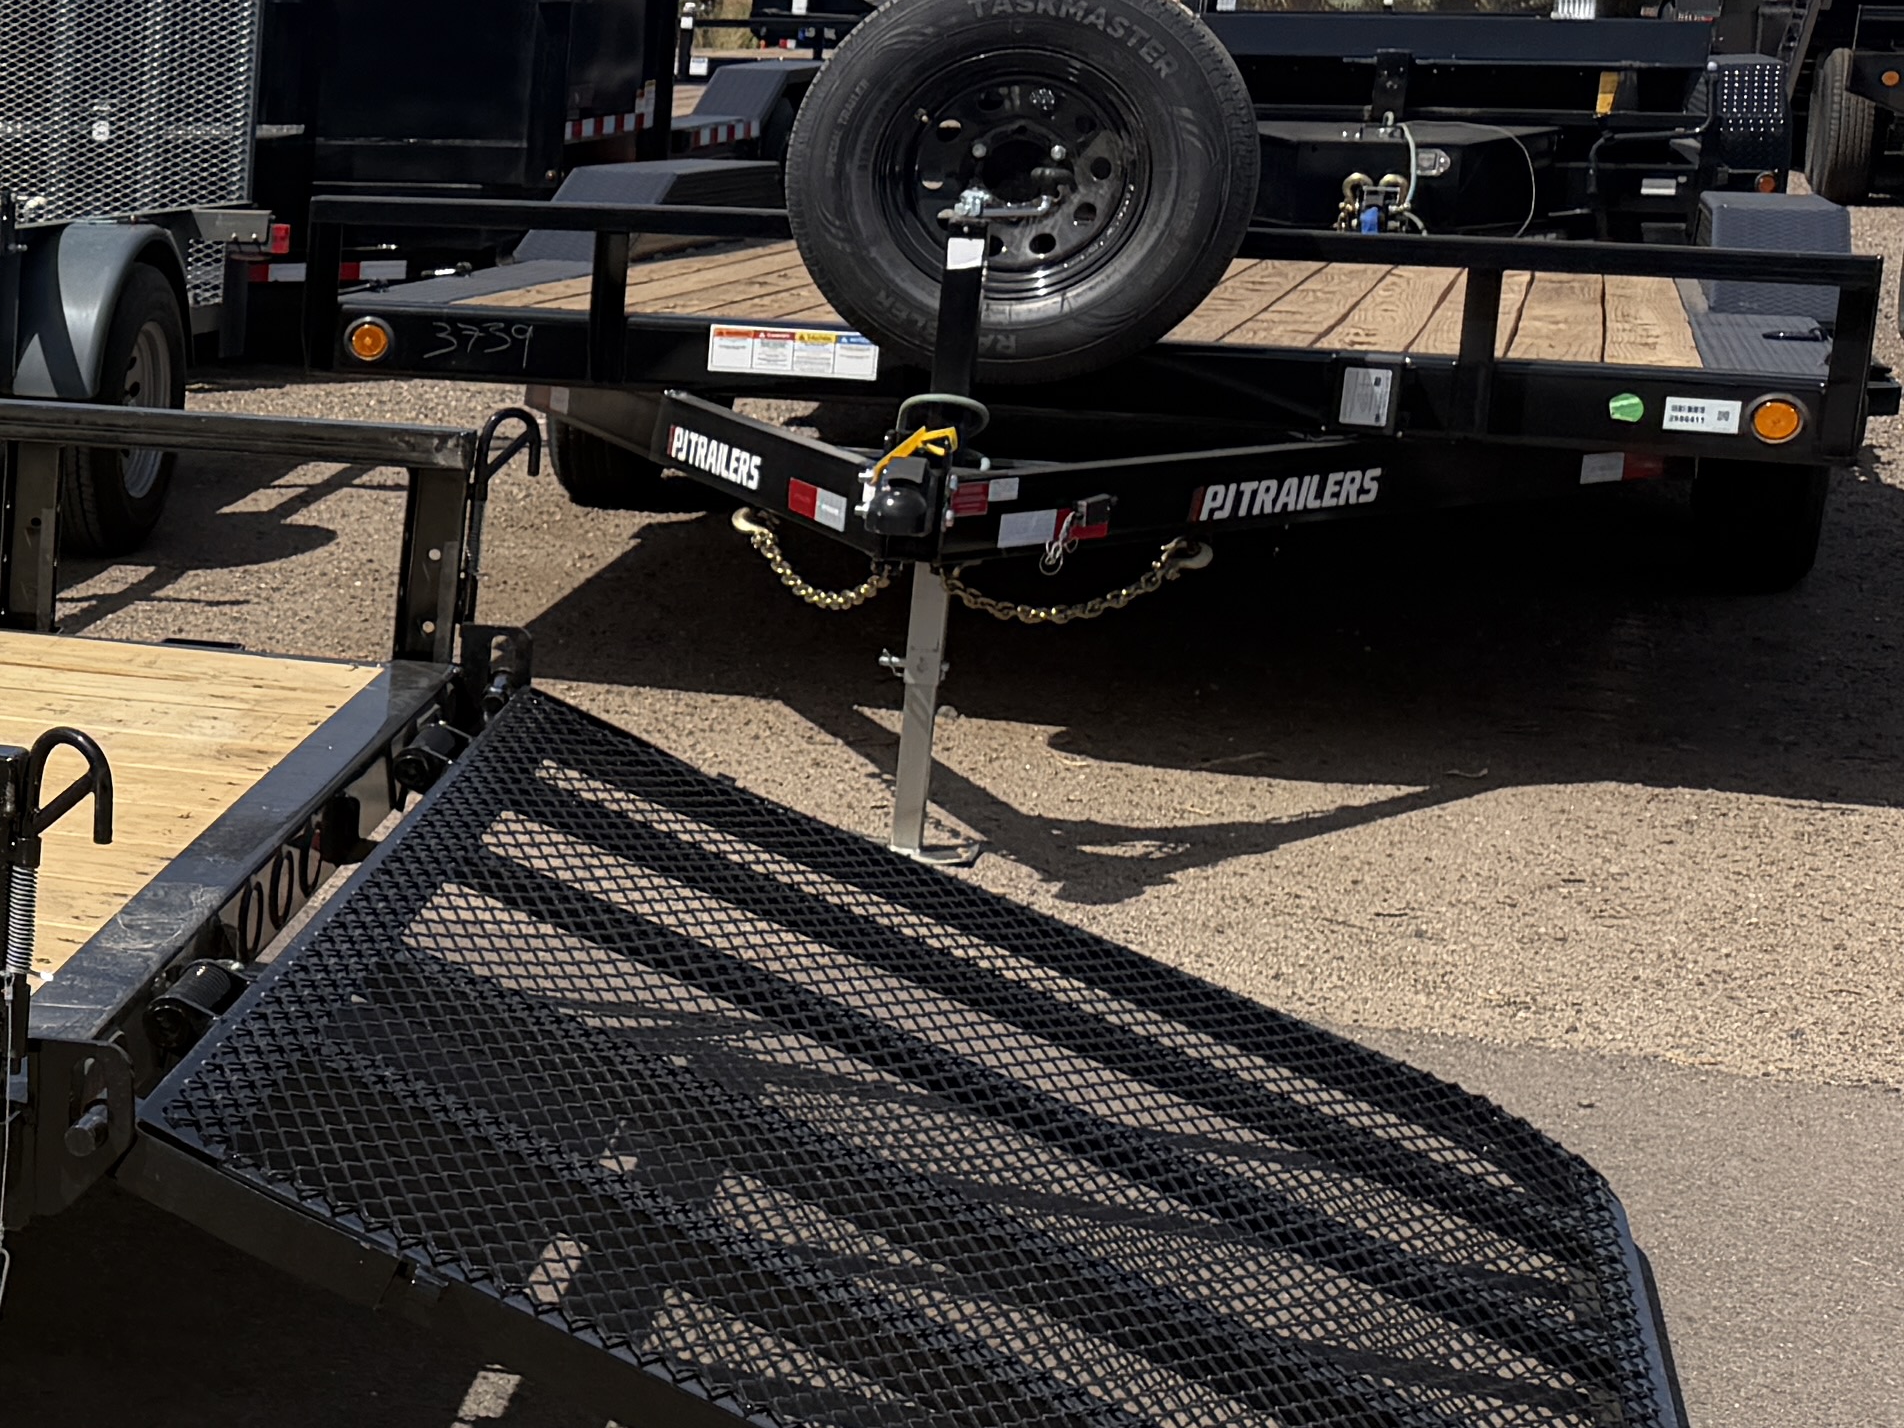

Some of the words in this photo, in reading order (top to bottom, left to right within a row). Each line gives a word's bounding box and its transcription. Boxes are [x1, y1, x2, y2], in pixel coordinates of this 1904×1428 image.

[423, 321, 534, 369] 3739
[671, 426, 689, 462] PJ
[688, 431, 762, 490] TRAILERS
[1199, 483, 1238, 522] PJ
[1238, 467, 1382, 517] TRAILERS
